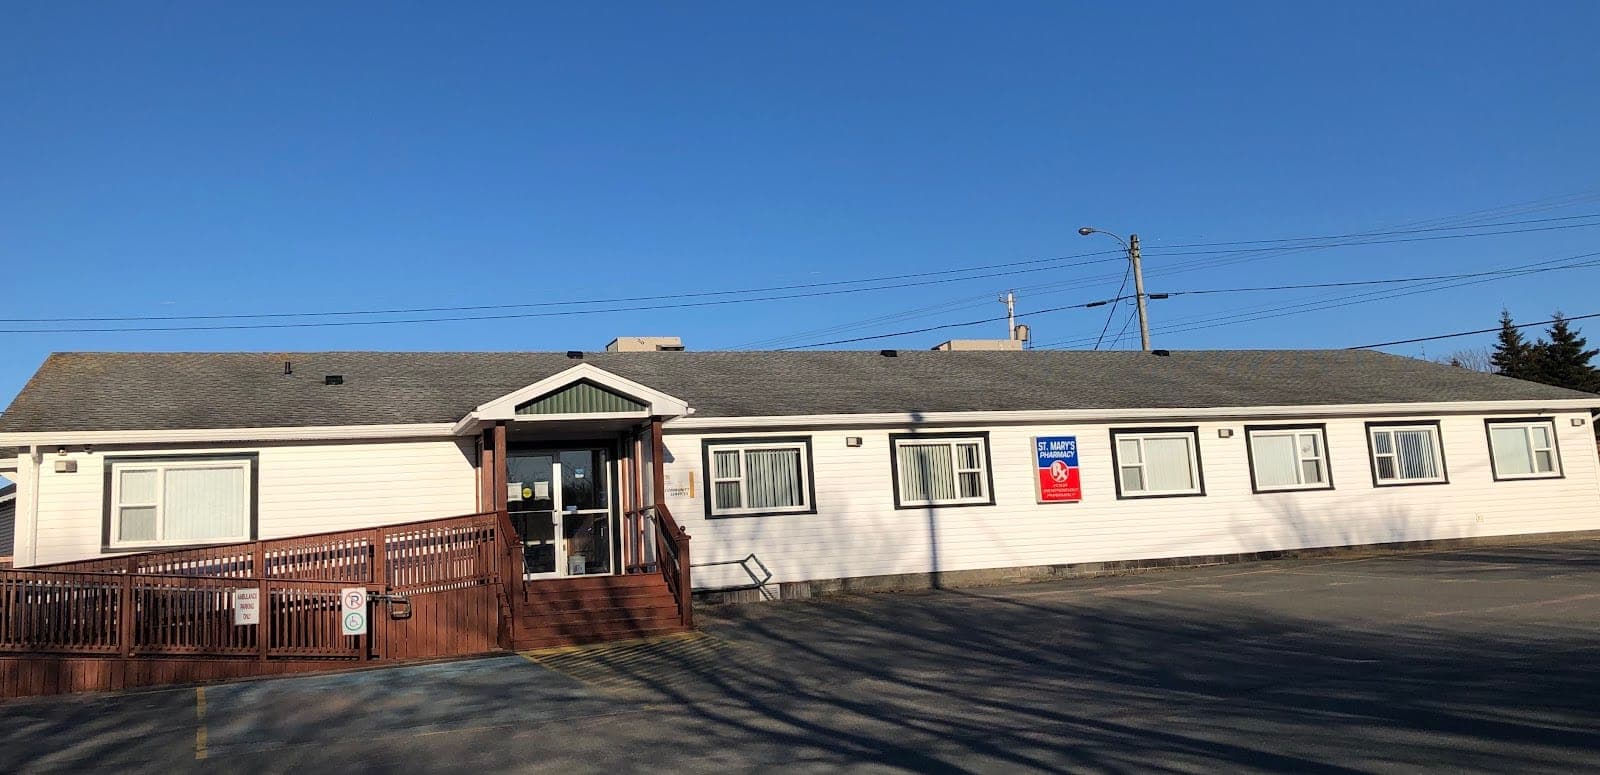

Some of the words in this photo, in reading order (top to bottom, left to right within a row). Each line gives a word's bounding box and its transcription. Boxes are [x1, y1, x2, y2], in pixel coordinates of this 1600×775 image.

[1038, 441, 1049, 451] ST.
[1050, 440, 1076, 451] MARY'S
[1039, 450, 1075, 459] PHARMACY
[350, 595, 360, 606] P
